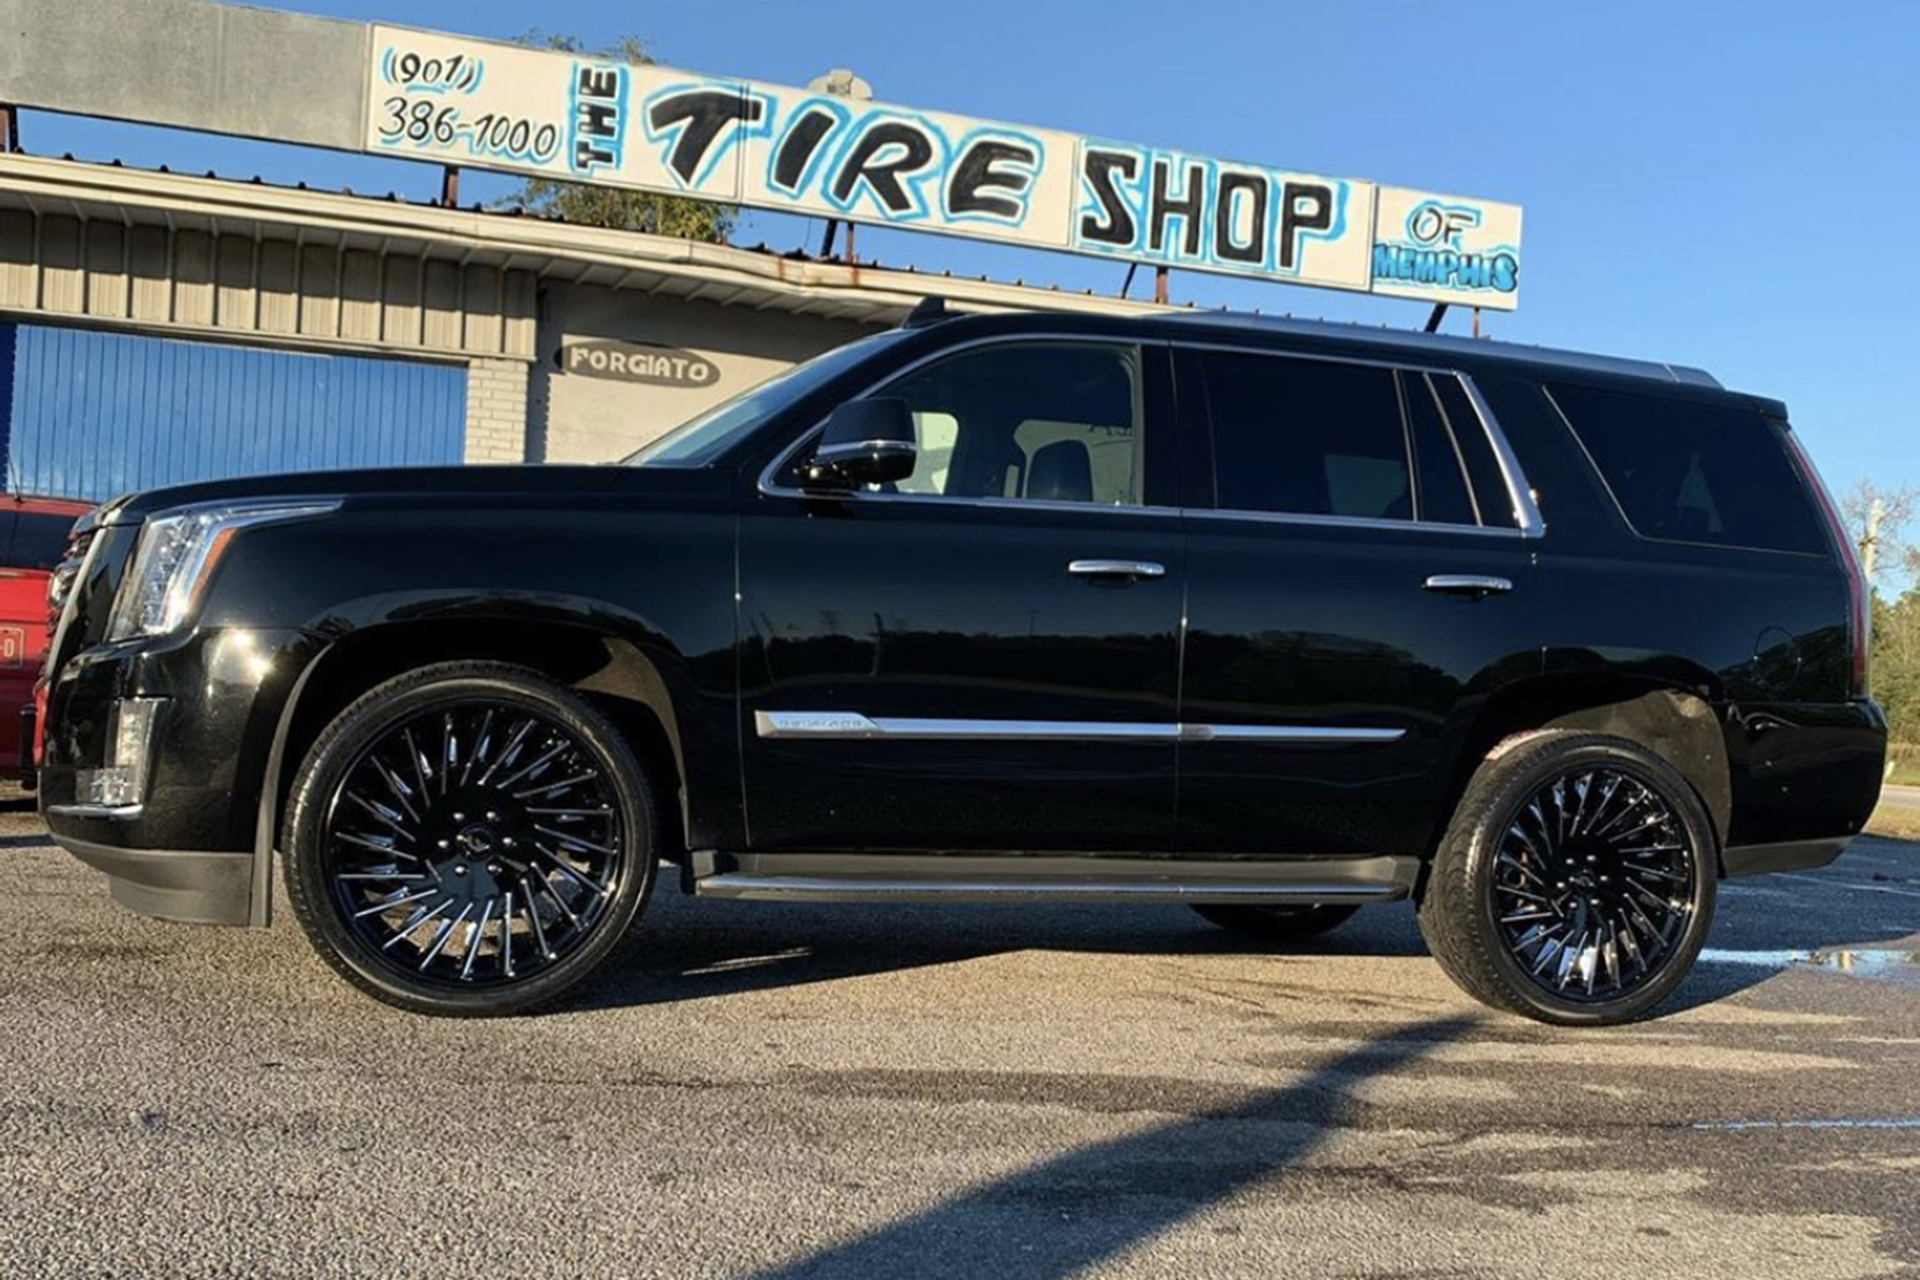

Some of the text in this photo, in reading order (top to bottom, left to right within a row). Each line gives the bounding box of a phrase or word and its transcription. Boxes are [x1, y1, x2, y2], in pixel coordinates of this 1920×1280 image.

[391, 52, 474, 90] (901)
[378, 96, 556, 156] 386-1000
[576, 67, 617, 169] THE
[650, 90, 1332, 268] TIRE SHOP
[1412, 207, 1474, 244] OF
[1373, 243, 1518, 293] MEMPHIS
[570, 347, 708, 381] FORGIATO
